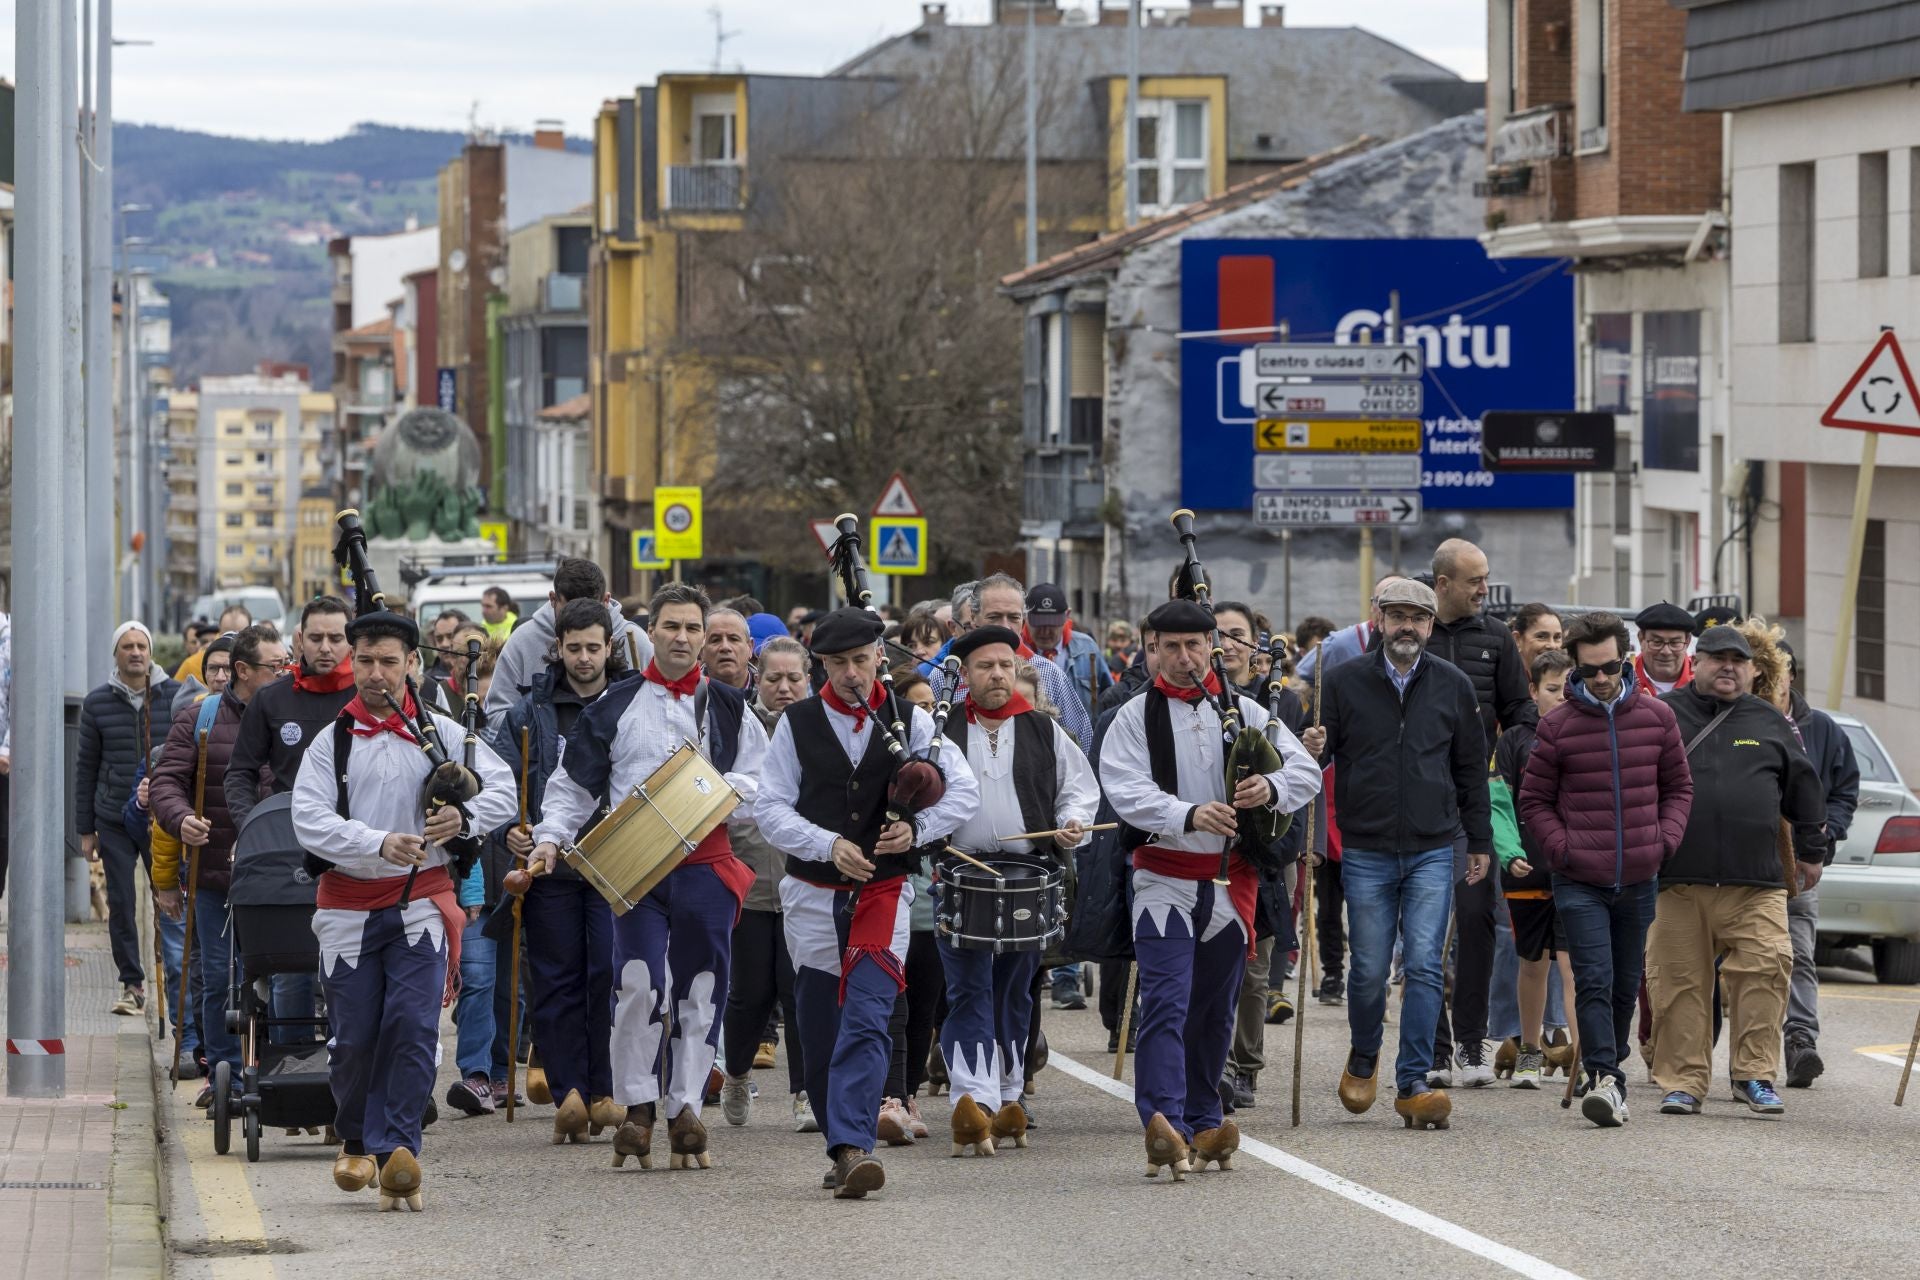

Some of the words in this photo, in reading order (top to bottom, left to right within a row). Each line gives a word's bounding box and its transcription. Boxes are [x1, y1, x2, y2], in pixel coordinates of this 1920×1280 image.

[1261, 355, 1309, 368] centro
[1314, 355, 1366, 368] ciudad
[1364, 385, 1417, 397] TANOS
[1359, 399, 1417, 411] OVIEDO
[1424, 420, 1436, 435] y
[1334, 435, 1416, 448] autobuses
[1434, 471, 1464, 487] 890
[1464, 471, 1495, 487] 690
[1260, 497, 1278, 508] LA
[1283, 497, 1383, 508] INMOBILIARIA
[1260, 510, 1331, 521] BARREDA
